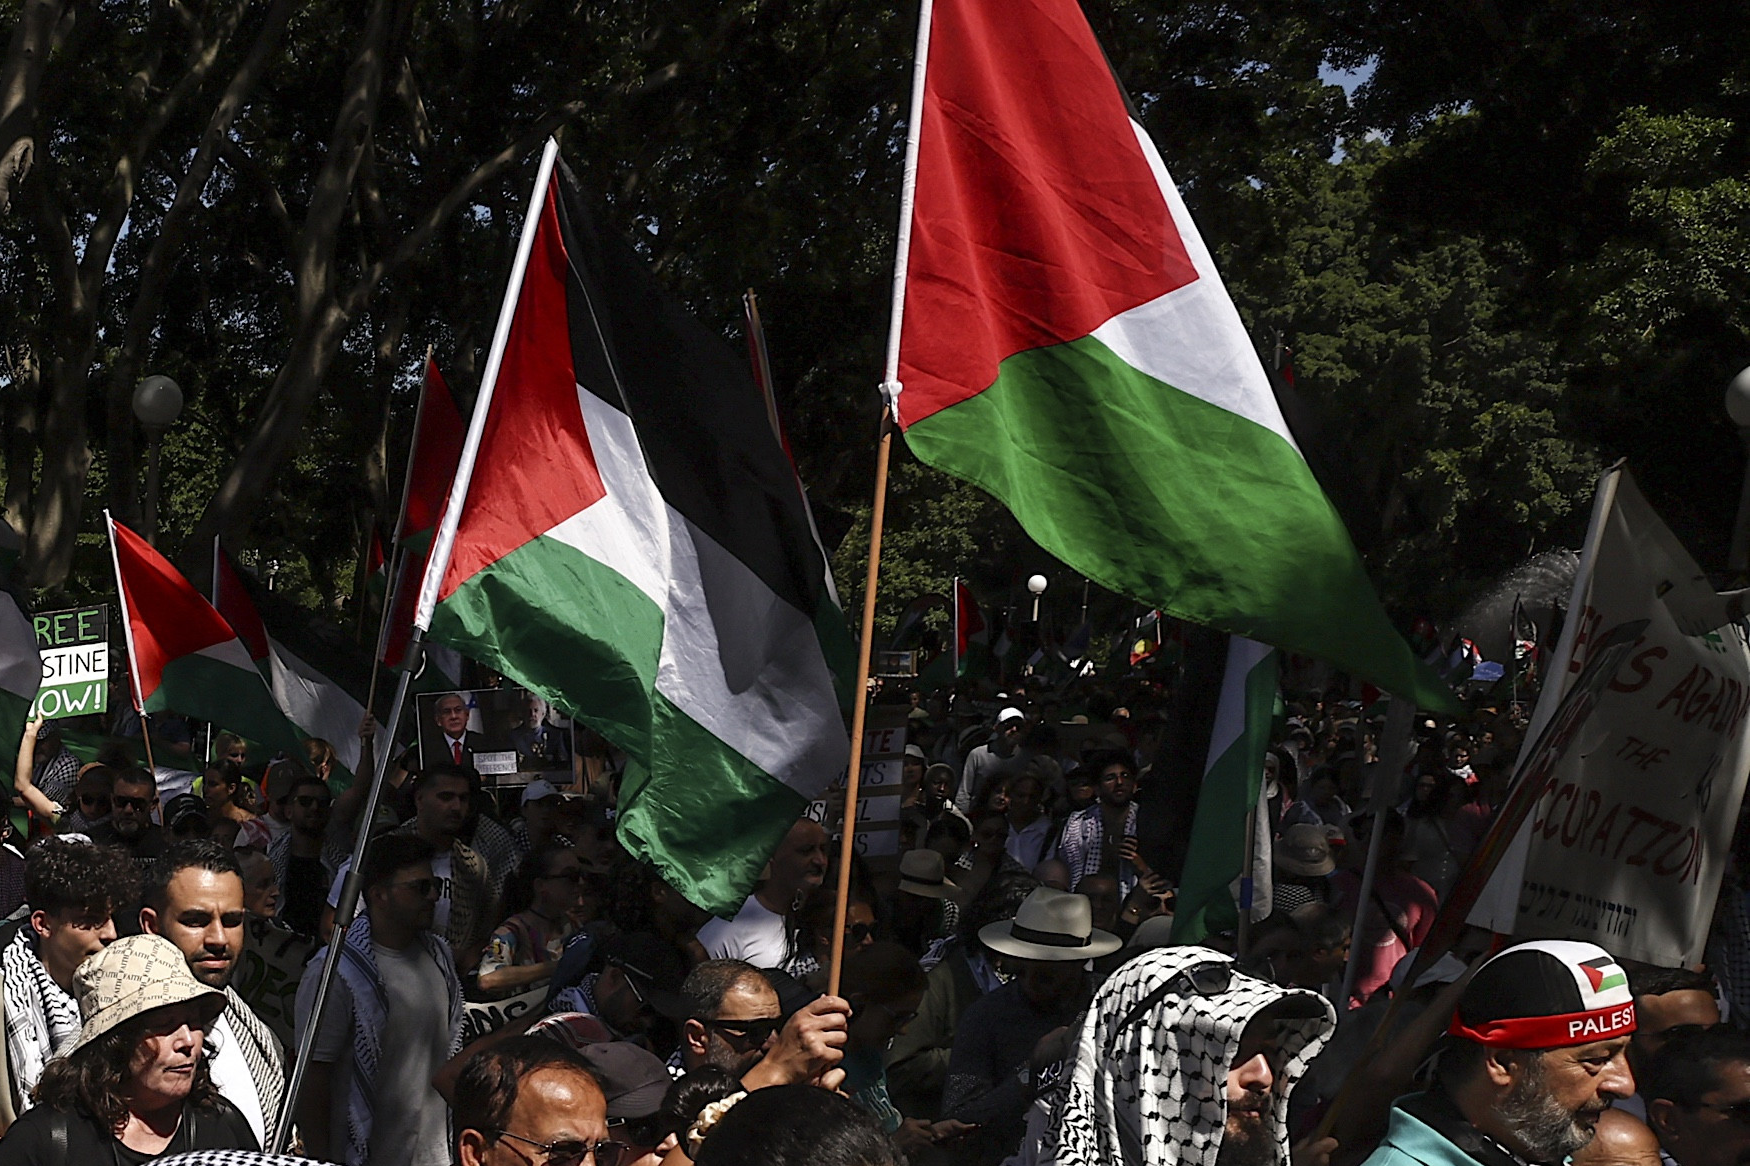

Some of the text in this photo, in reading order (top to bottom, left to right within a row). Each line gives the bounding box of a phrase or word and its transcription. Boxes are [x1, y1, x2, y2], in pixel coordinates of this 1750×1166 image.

[33, 610, 99, 646] REE
[42, 649, 106, 679] STINE
[1617, 735, 1670, 772] THE
